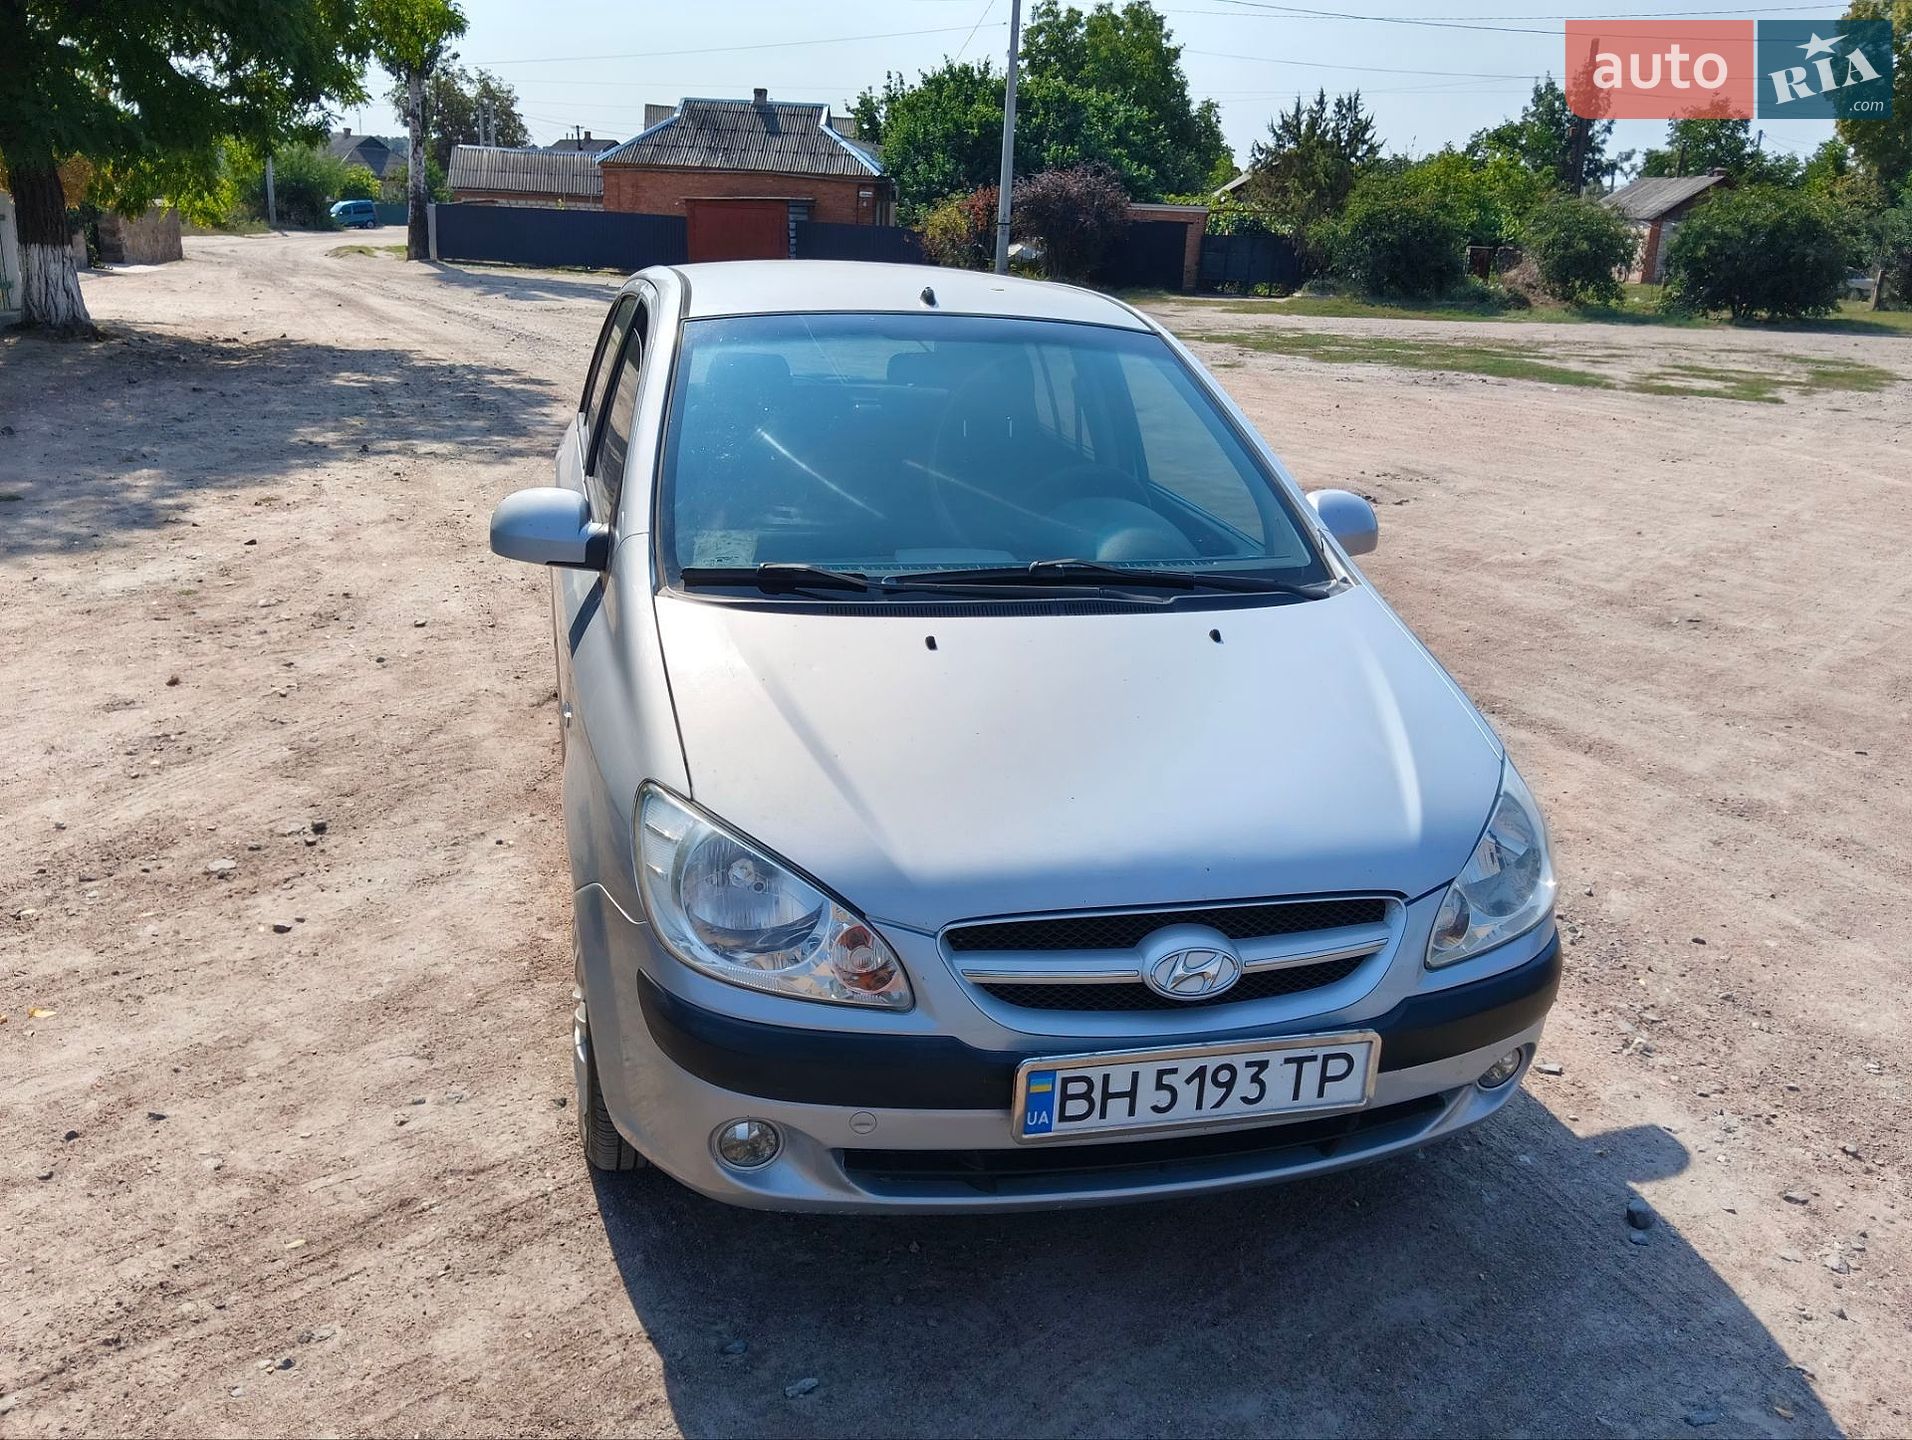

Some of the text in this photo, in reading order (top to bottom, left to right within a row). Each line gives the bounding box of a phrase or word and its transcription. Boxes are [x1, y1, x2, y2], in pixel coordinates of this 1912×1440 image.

[1058, 1052, 1355, 1123] BH 5193 TP
[1026, 1111, 1050, 1126] UA
